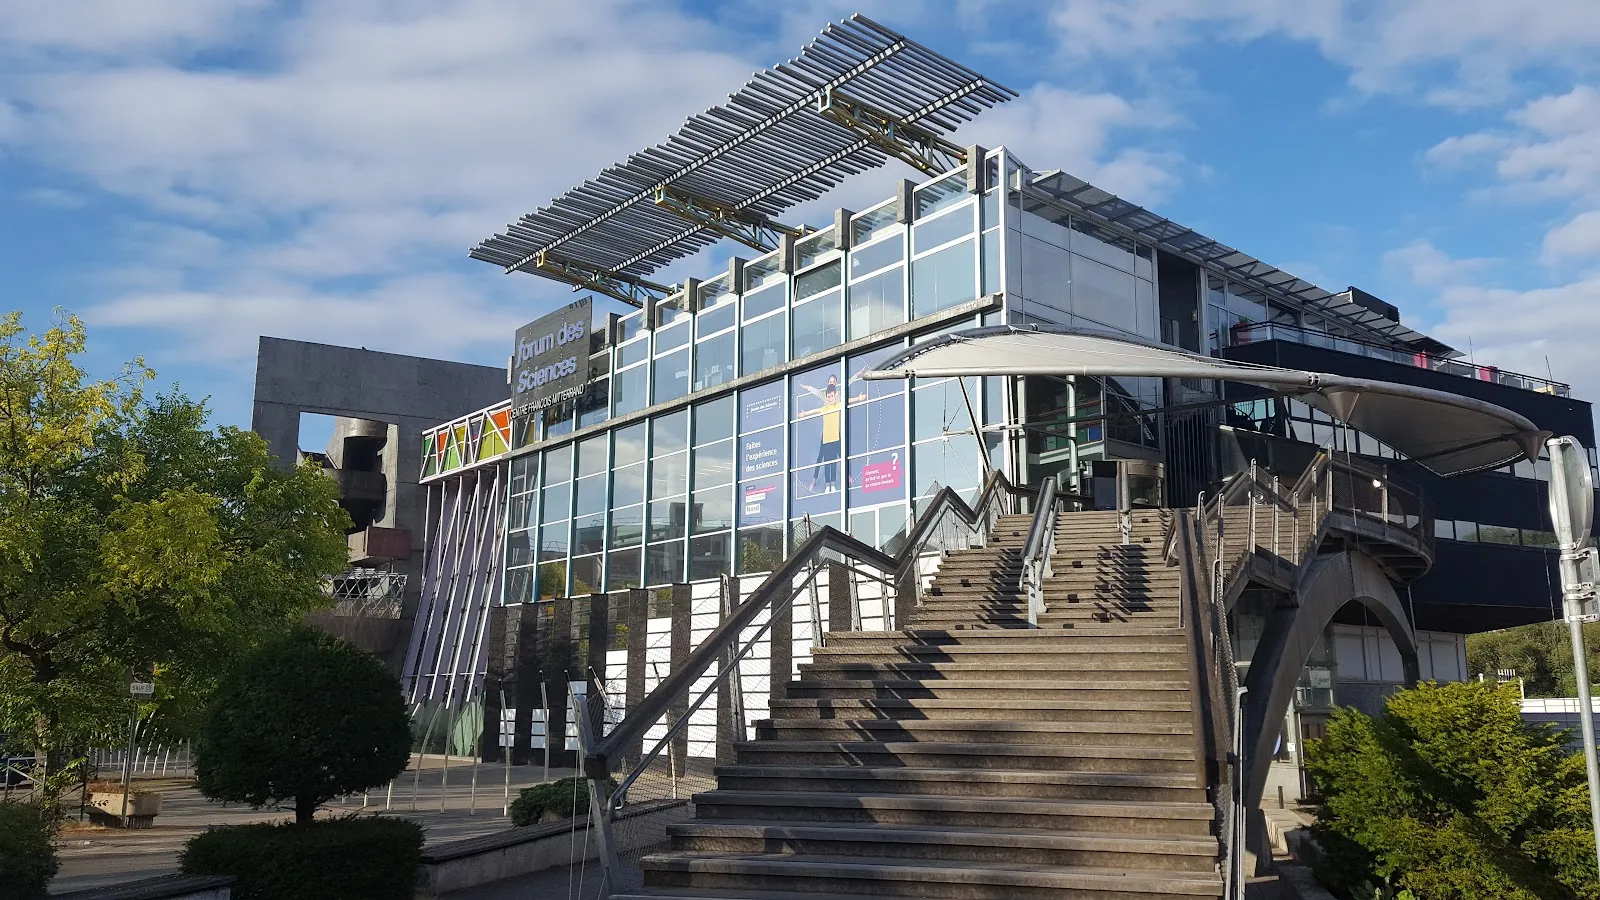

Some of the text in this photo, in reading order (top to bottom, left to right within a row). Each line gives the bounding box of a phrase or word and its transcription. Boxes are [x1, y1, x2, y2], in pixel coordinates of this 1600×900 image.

[515, 321, 584, 369] forum des
[516, 356, 577, 393] Sciences
[552, 384, 584, 404] MITTERRAND
[746, 441, 761, 450] Faites
[745, 449, 777, 461] l'expérience
[745, 460, 778, 473] des sciences
[746, 504, 760, 513] Nord
